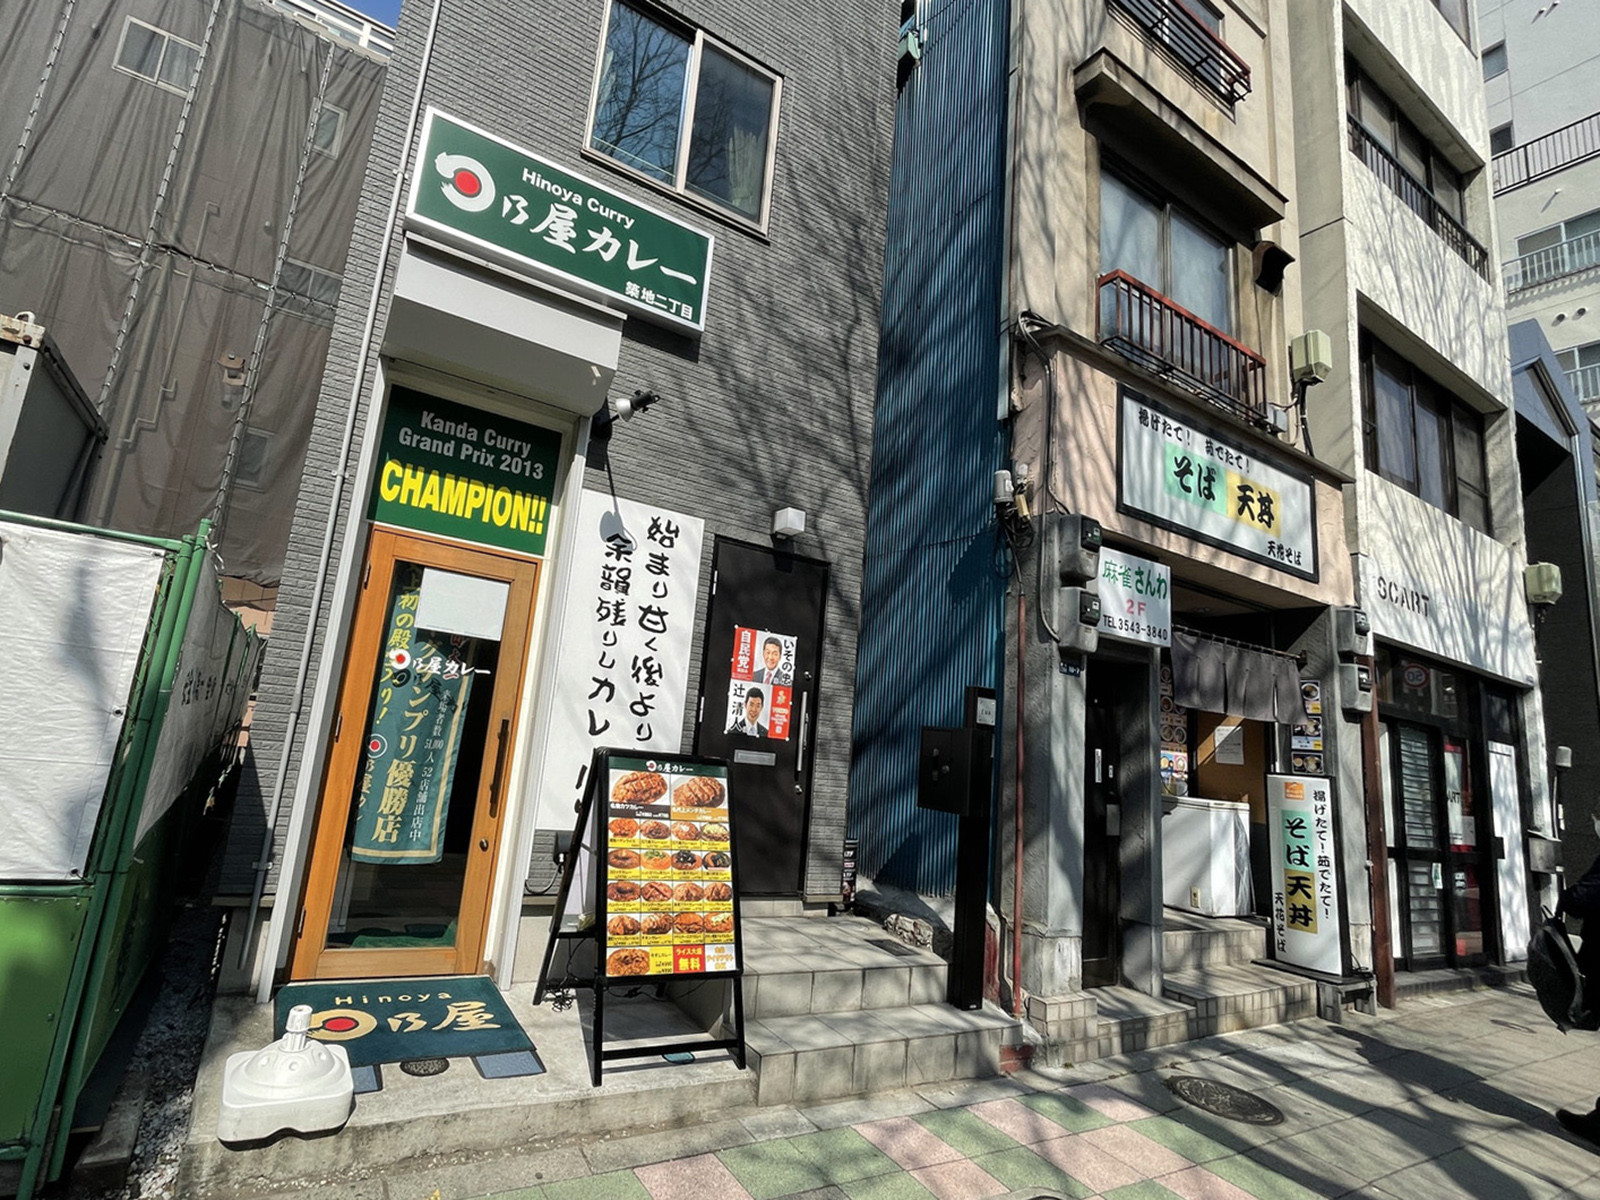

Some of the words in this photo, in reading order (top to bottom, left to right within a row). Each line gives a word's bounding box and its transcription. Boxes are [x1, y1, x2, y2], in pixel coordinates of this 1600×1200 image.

[522, 168, 583, 206] Hinoya
[587, 197, 635, 229] Curry
[625, 280, 694, 320] 築地二丁目
[399, 427, 455, 457] Grand
[460, 443, 494, 467] Prix
[500, 454, 544, 480] 2013
[421, 410, 478, 442] Kanda
[484, 428, 531, 458] Curry
[380, 459, 547, 535] CHAMPION!!
[1173, 455, 1217, 501] そば
[1237, 484, 1275, 529] 天丼
[1125, 599, 1147, 616] 2F
[1377, 576, 1430, 617] SCART
[629, 516, 680, 742] 始まり甘く後より
[1103, 615, 1117, 629] TEL
[1118, 619, 1168, 640] 3543-3840
[1285, 817, 1311, 868] そば
[1286, 874, 1314, 928] 天丼
[335, 992, 452, 1005] Hinoya
